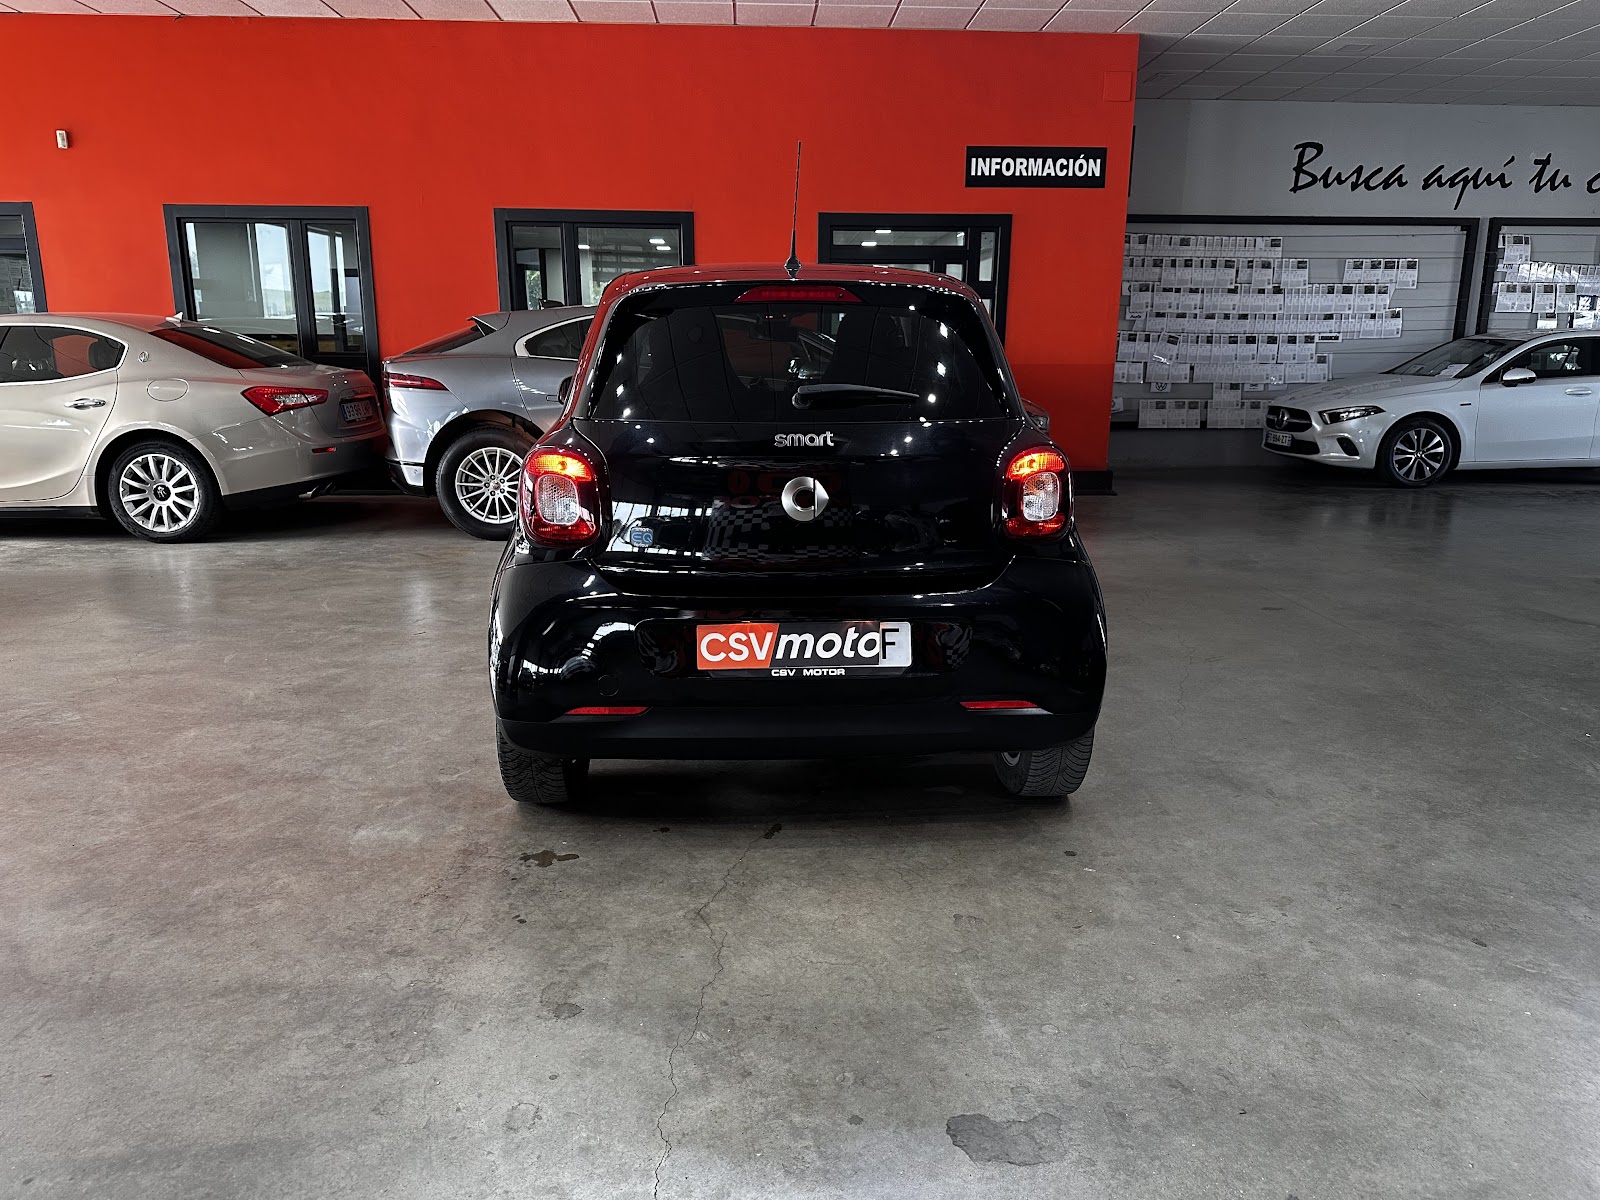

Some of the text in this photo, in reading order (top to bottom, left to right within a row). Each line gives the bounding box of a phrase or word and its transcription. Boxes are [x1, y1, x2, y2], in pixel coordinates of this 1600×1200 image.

[970, 154, 1101, 177] INFORMACIÓN
[1289, 141, 1408, 193] Busca
[1421, 155, 1516, 211] aquí
[1529, 152, 1572, 193] tu
[774, 431, 834, 447] smart
[631, 532, 652, 543] EQ
[771, 668, 846, 677] CSV MOTOR
